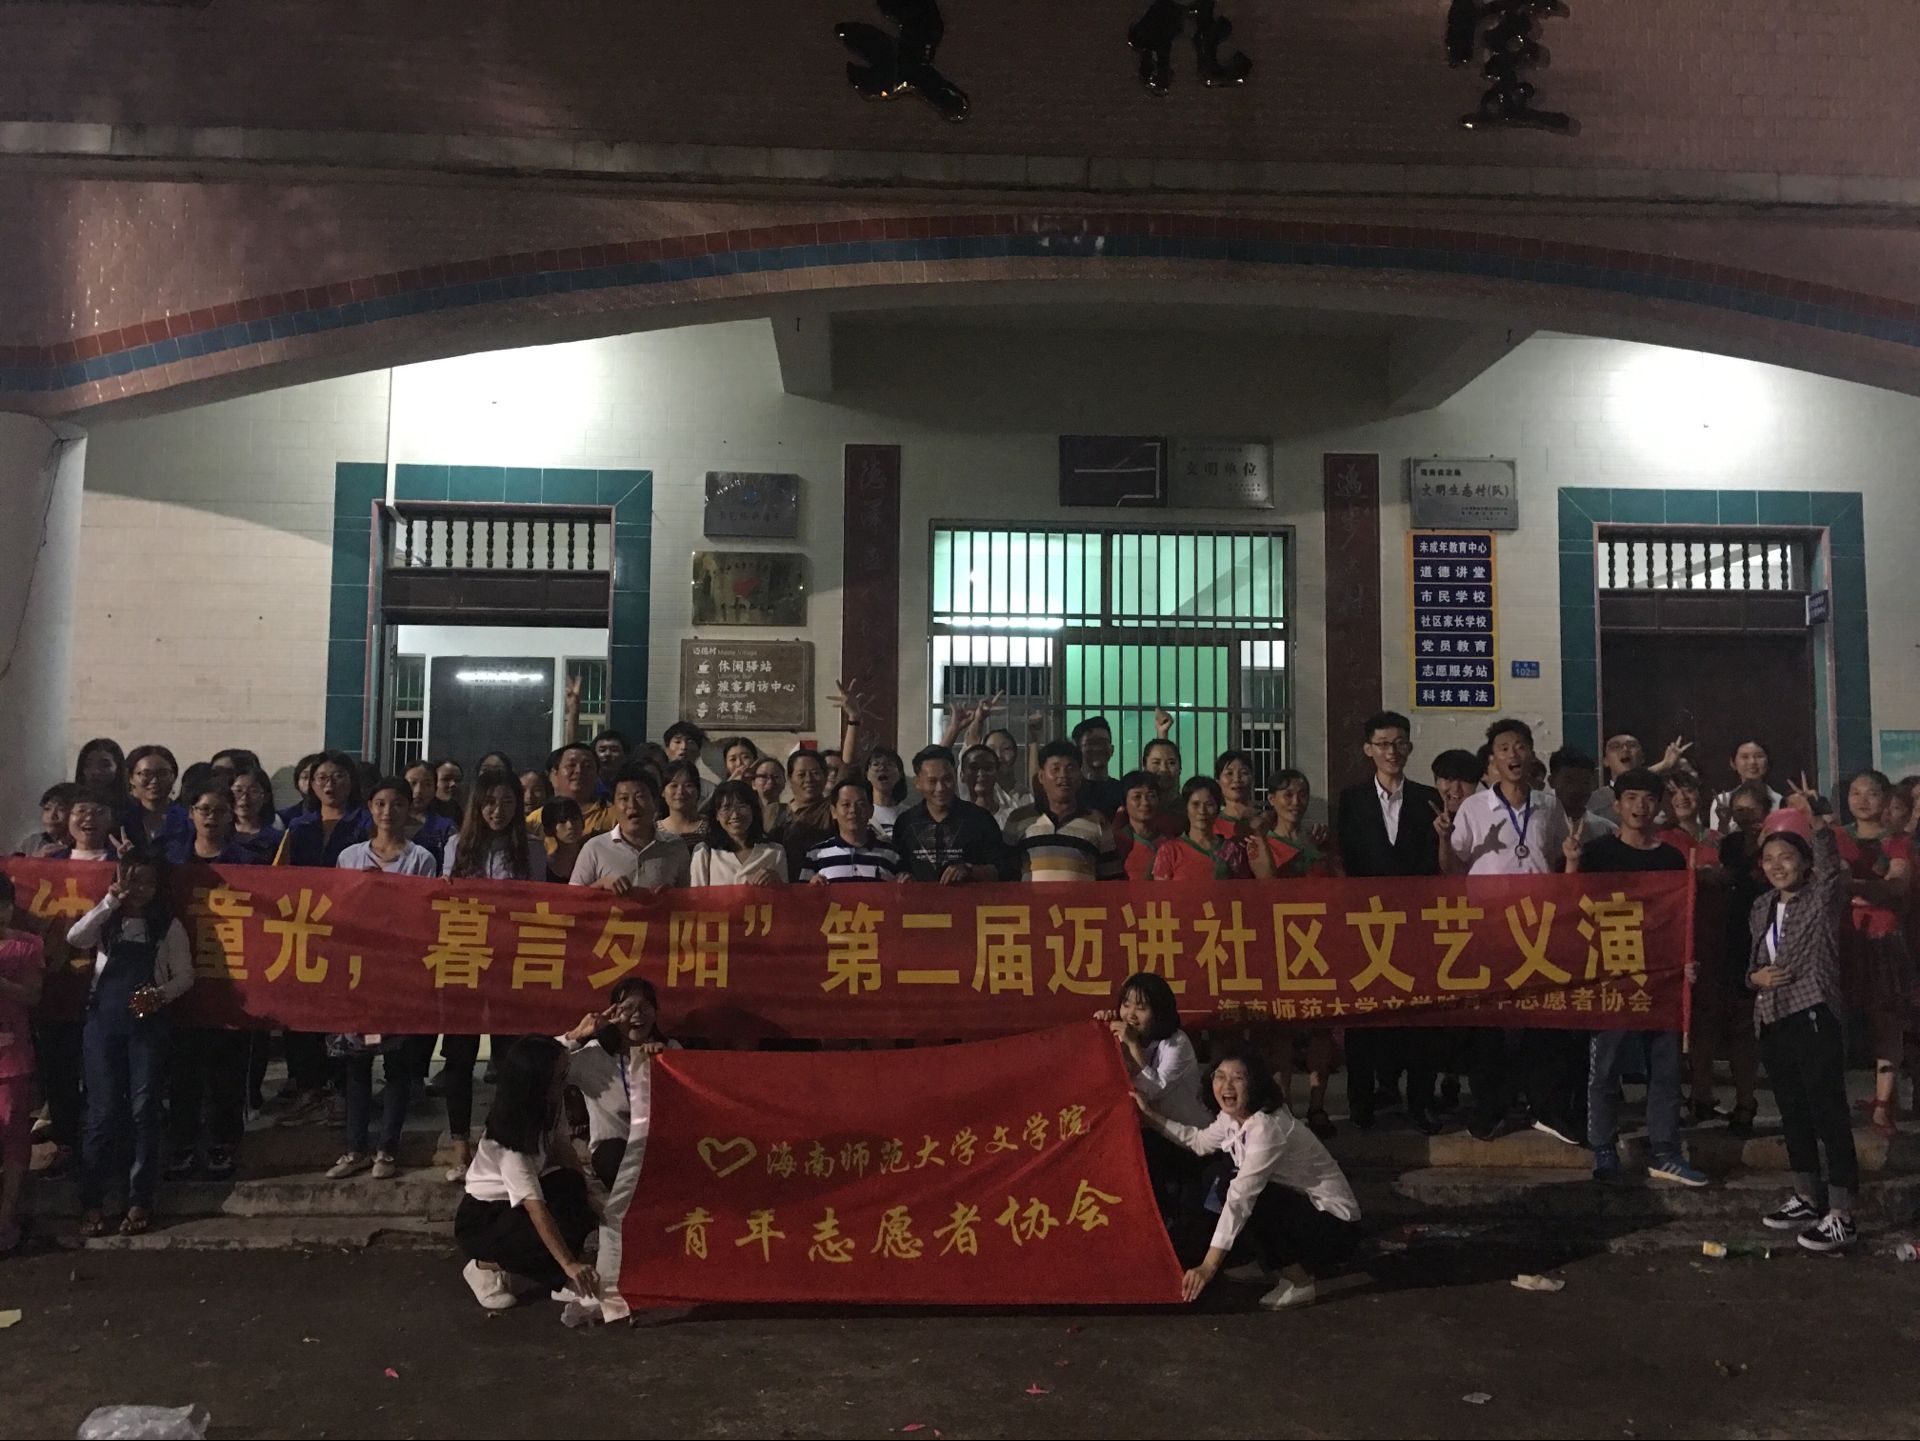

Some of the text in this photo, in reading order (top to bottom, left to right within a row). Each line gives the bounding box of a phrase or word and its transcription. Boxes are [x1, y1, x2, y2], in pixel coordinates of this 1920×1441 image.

[1187, 461, 1257, 477] 文明单位
[1419, 541, 1487, 554] 未成年教育中心
[1420, 566, 1486, 579] 道德讲堂
[1421, 590, 1486, 603] 市民学校
[1421, 615, 1487, 628] 社区家长学校
[1421, 640, 1487, 653] 党员教育
[719, 660, 772, 673] 休闲驿站
[1422, 665, 1488, 678] 志愿服务站
[1422, 690, 1488, 703] 科技普法
[717, 701, 757, 714] 农家乐
[766, 1103, 1091, 1178] 海南师范大学文学院
[665, 1179, 1122, 1263] 青年志愿者协会
